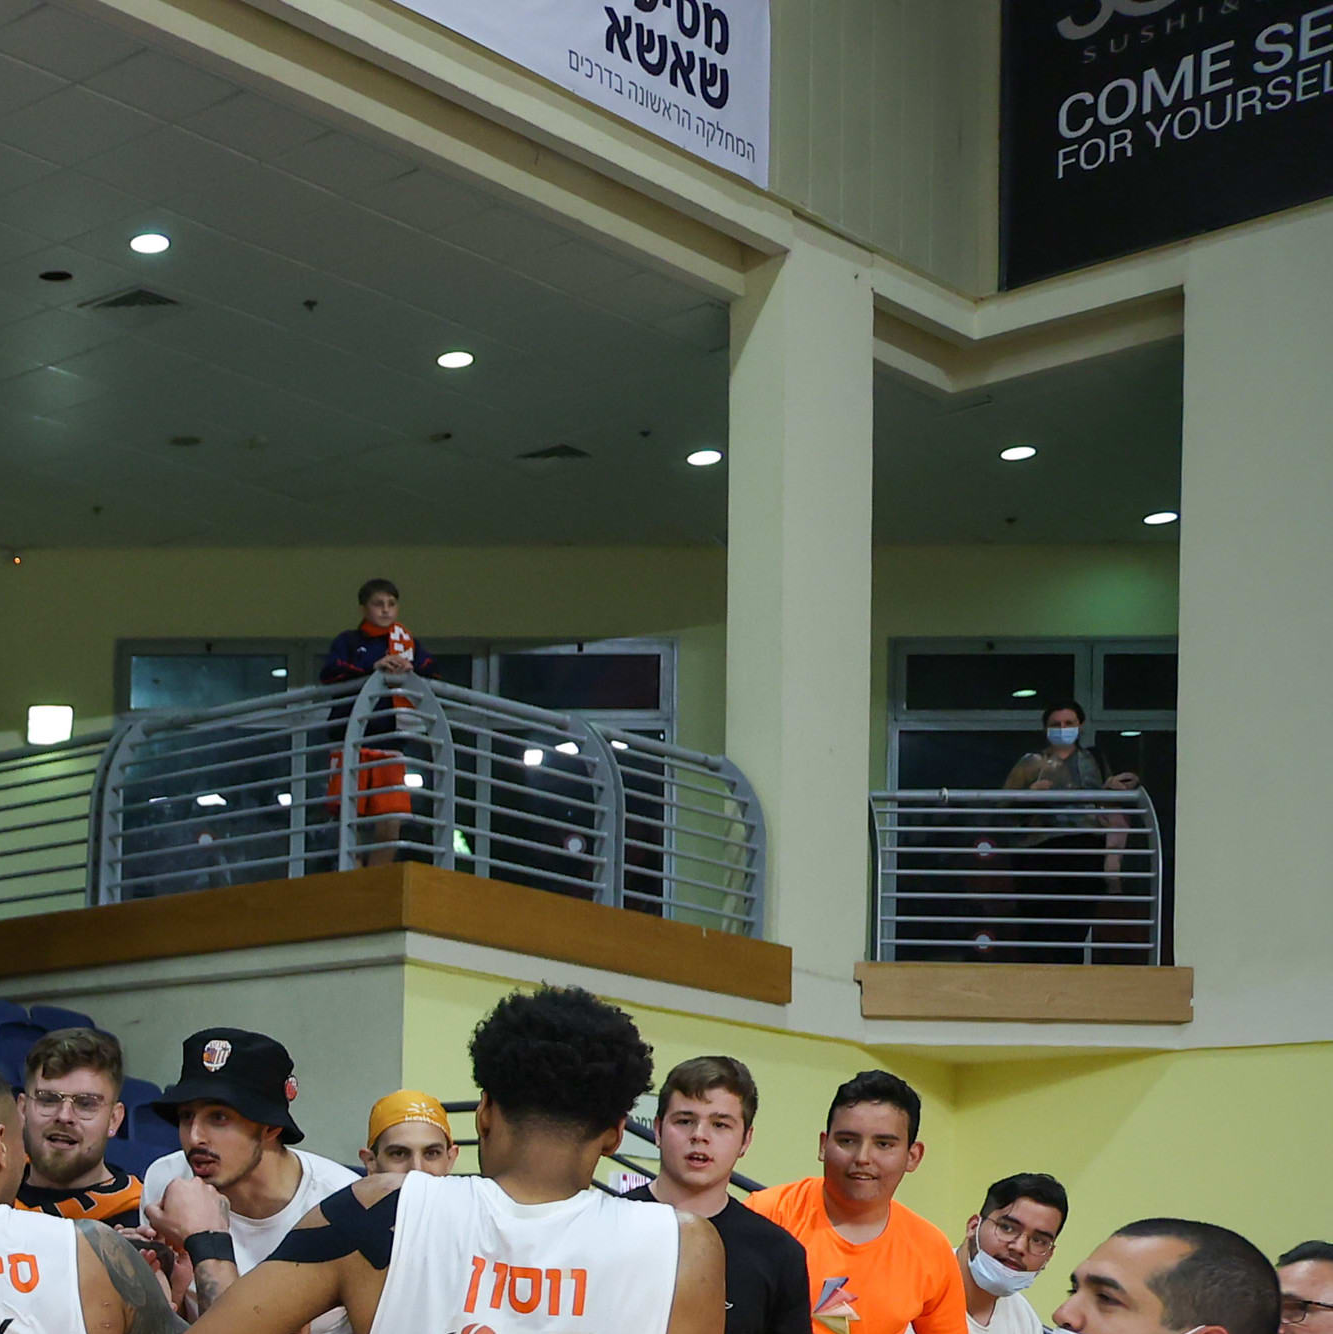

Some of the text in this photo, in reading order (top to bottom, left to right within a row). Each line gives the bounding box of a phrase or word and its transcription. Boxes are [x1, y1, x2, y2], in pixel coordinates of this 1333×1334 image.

[604, 6, 729, 109] שאשא
[1083, 7, 1204, 64] SUSHI
[568, 49, 755, 163] המחלקה הראשונה בדרכים
[1058, 40, 1235, 139] COME
[1057, 129, 1133, 179] FOR
[464, 1255, 587, 1316] ווסון
